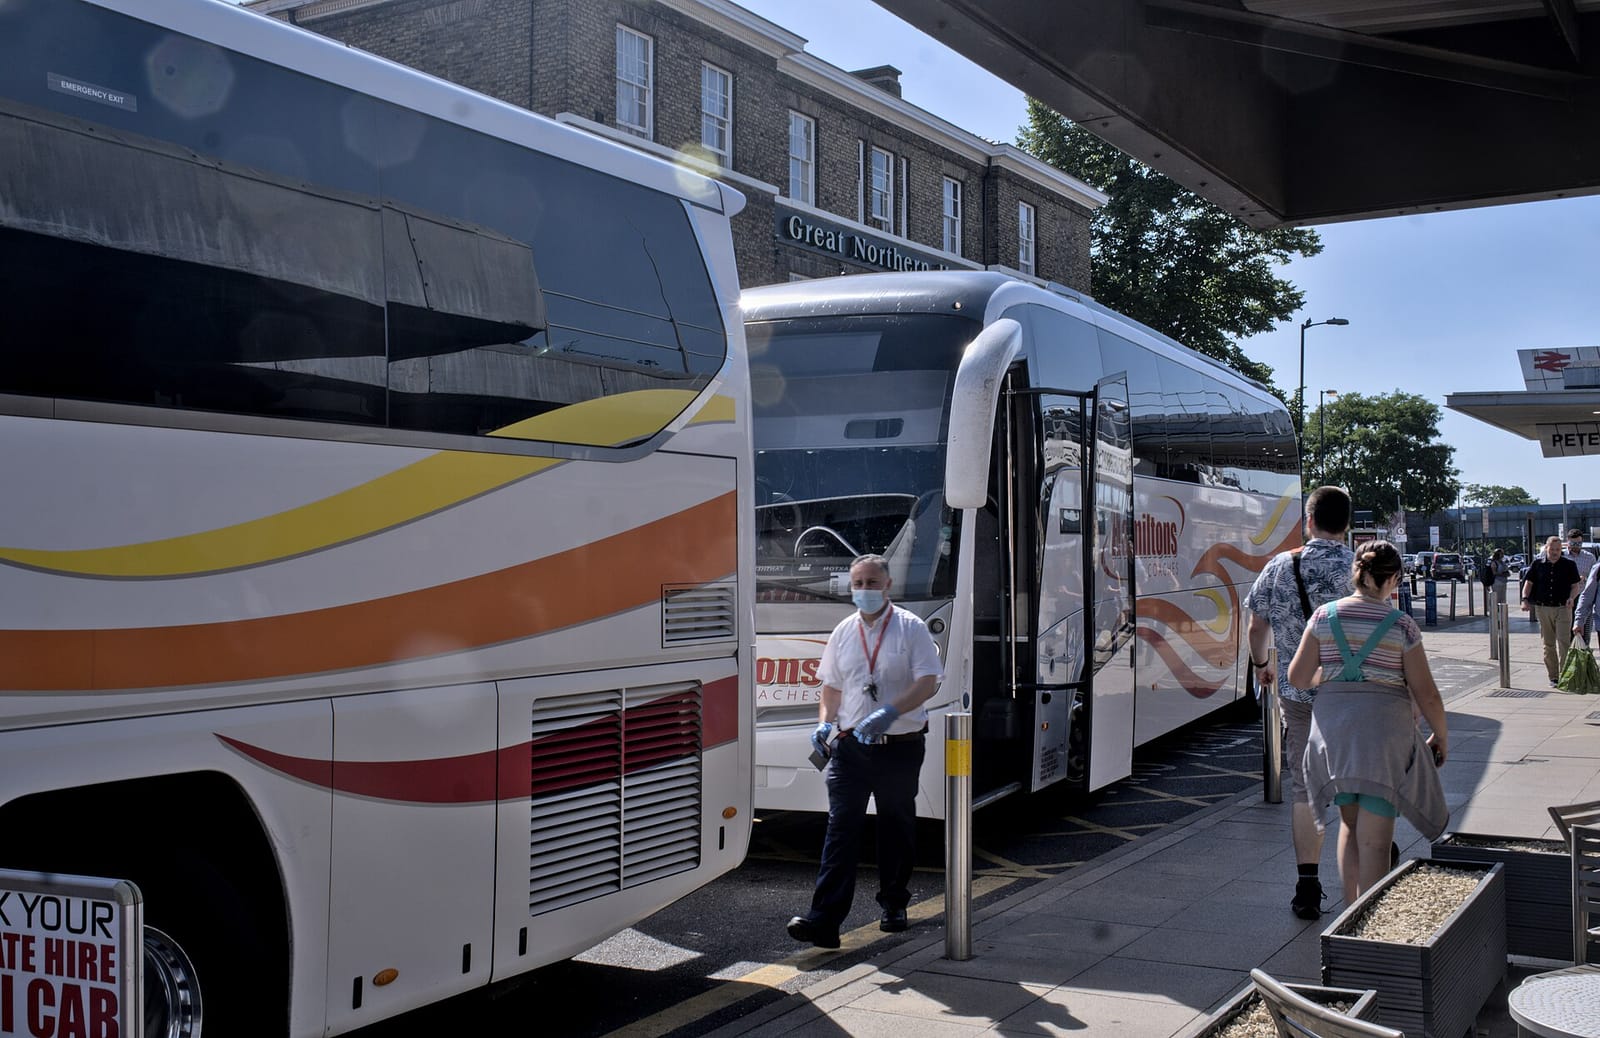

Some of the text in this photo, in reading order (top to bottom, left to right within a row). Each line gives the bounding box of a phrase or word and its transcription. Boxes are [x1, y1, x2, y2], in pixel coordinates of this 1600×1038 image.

[61, 80, 124, 104] EMERGENCY EXIT
[789, 215, 844, 253] Great
[1552, 432, 1600, 447] PETE
[758, 689, 822, 702] ACHES
[18, 893, 114, 938] YOUR
[45, 937, 116, 984] HIRE
[27, 978, 119, 1038] CAB
